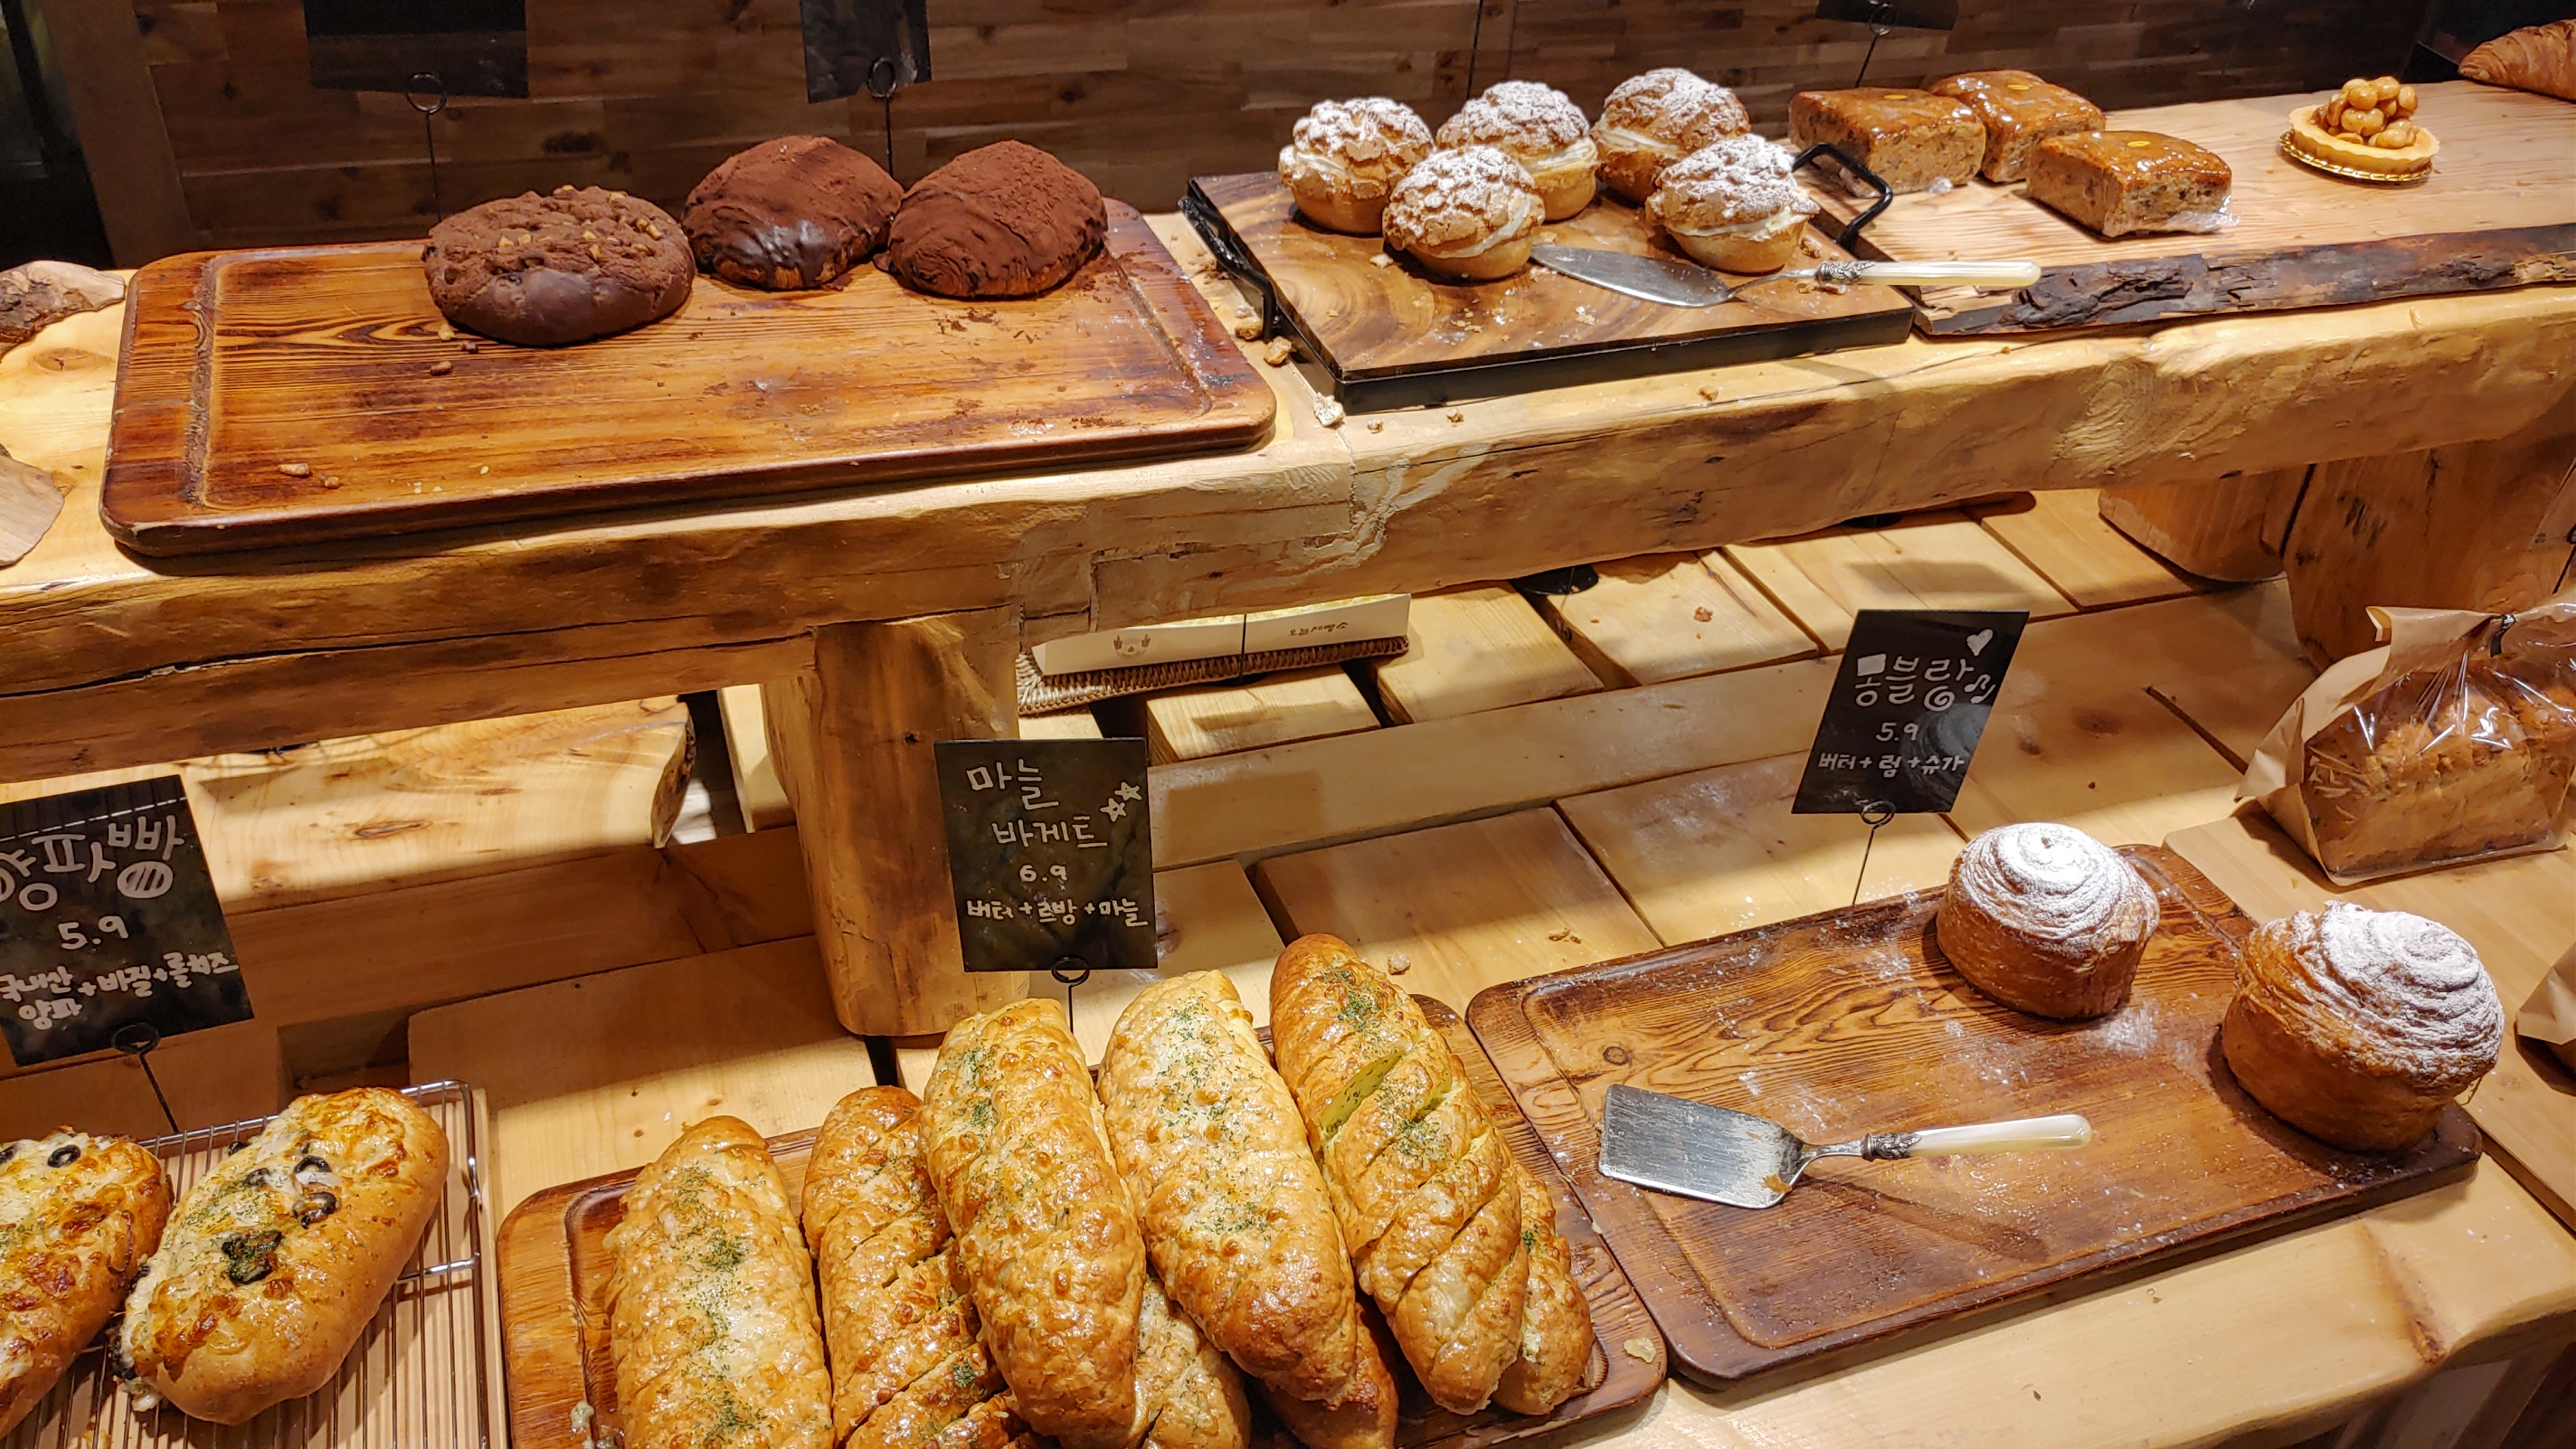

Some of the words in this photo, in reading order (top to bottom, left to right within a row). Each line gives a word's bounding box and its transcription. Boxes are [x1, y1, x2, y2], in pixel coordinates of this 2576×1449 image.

[1876, 722, 1918, 741] 5.9
[966, 759, 1059, 810] 마늘
[1019, 865, 1067, 882] 6.9
[58, 916, 128, 950] 5.9
